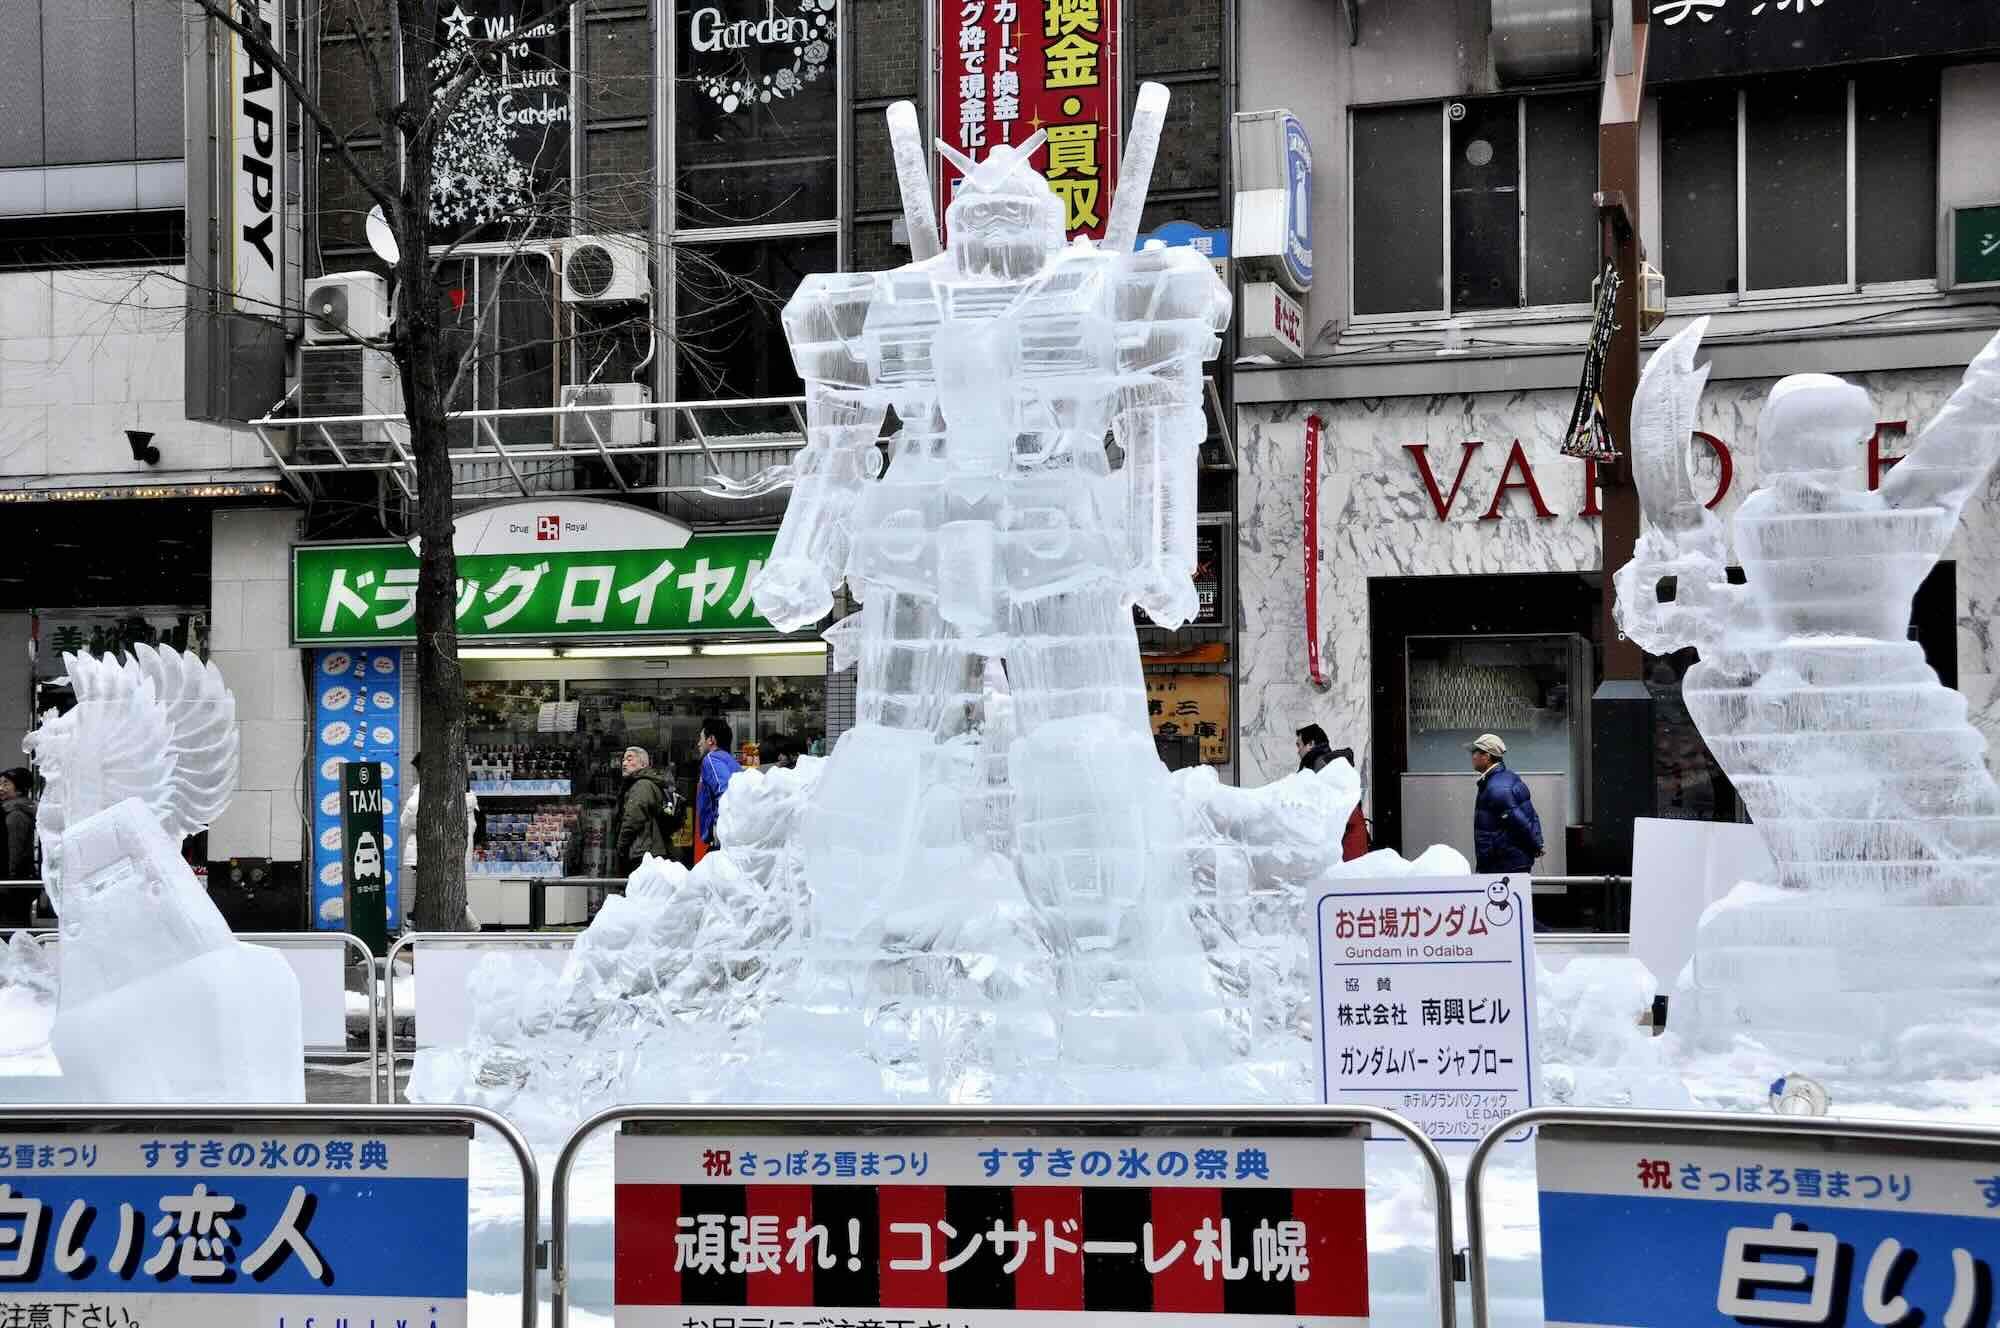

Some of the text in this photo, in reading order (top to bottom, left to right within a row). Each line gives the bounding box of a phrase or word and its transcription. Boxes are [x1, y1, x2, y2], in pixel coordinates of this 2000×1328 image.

[508, 42, 529, 58] to
[497, 92, 568, 125] Garden
[565, 522, 588, 533] Royal
[350, 788, 383, 814] TAXI
[1335, 904, 1489, 939] お台場ガンダム
[1345, 944, 1473, 959] Gundam in Odaiba
[1337, 997, 1511, 1026] 株式会社 南興ビル
[1466, 1109, 1480, 1120] LE
[140, 1140, 389, 1171] すすきの氷の祭典
[977, 1148, 1270, 1180] すすきの氷の祭典
